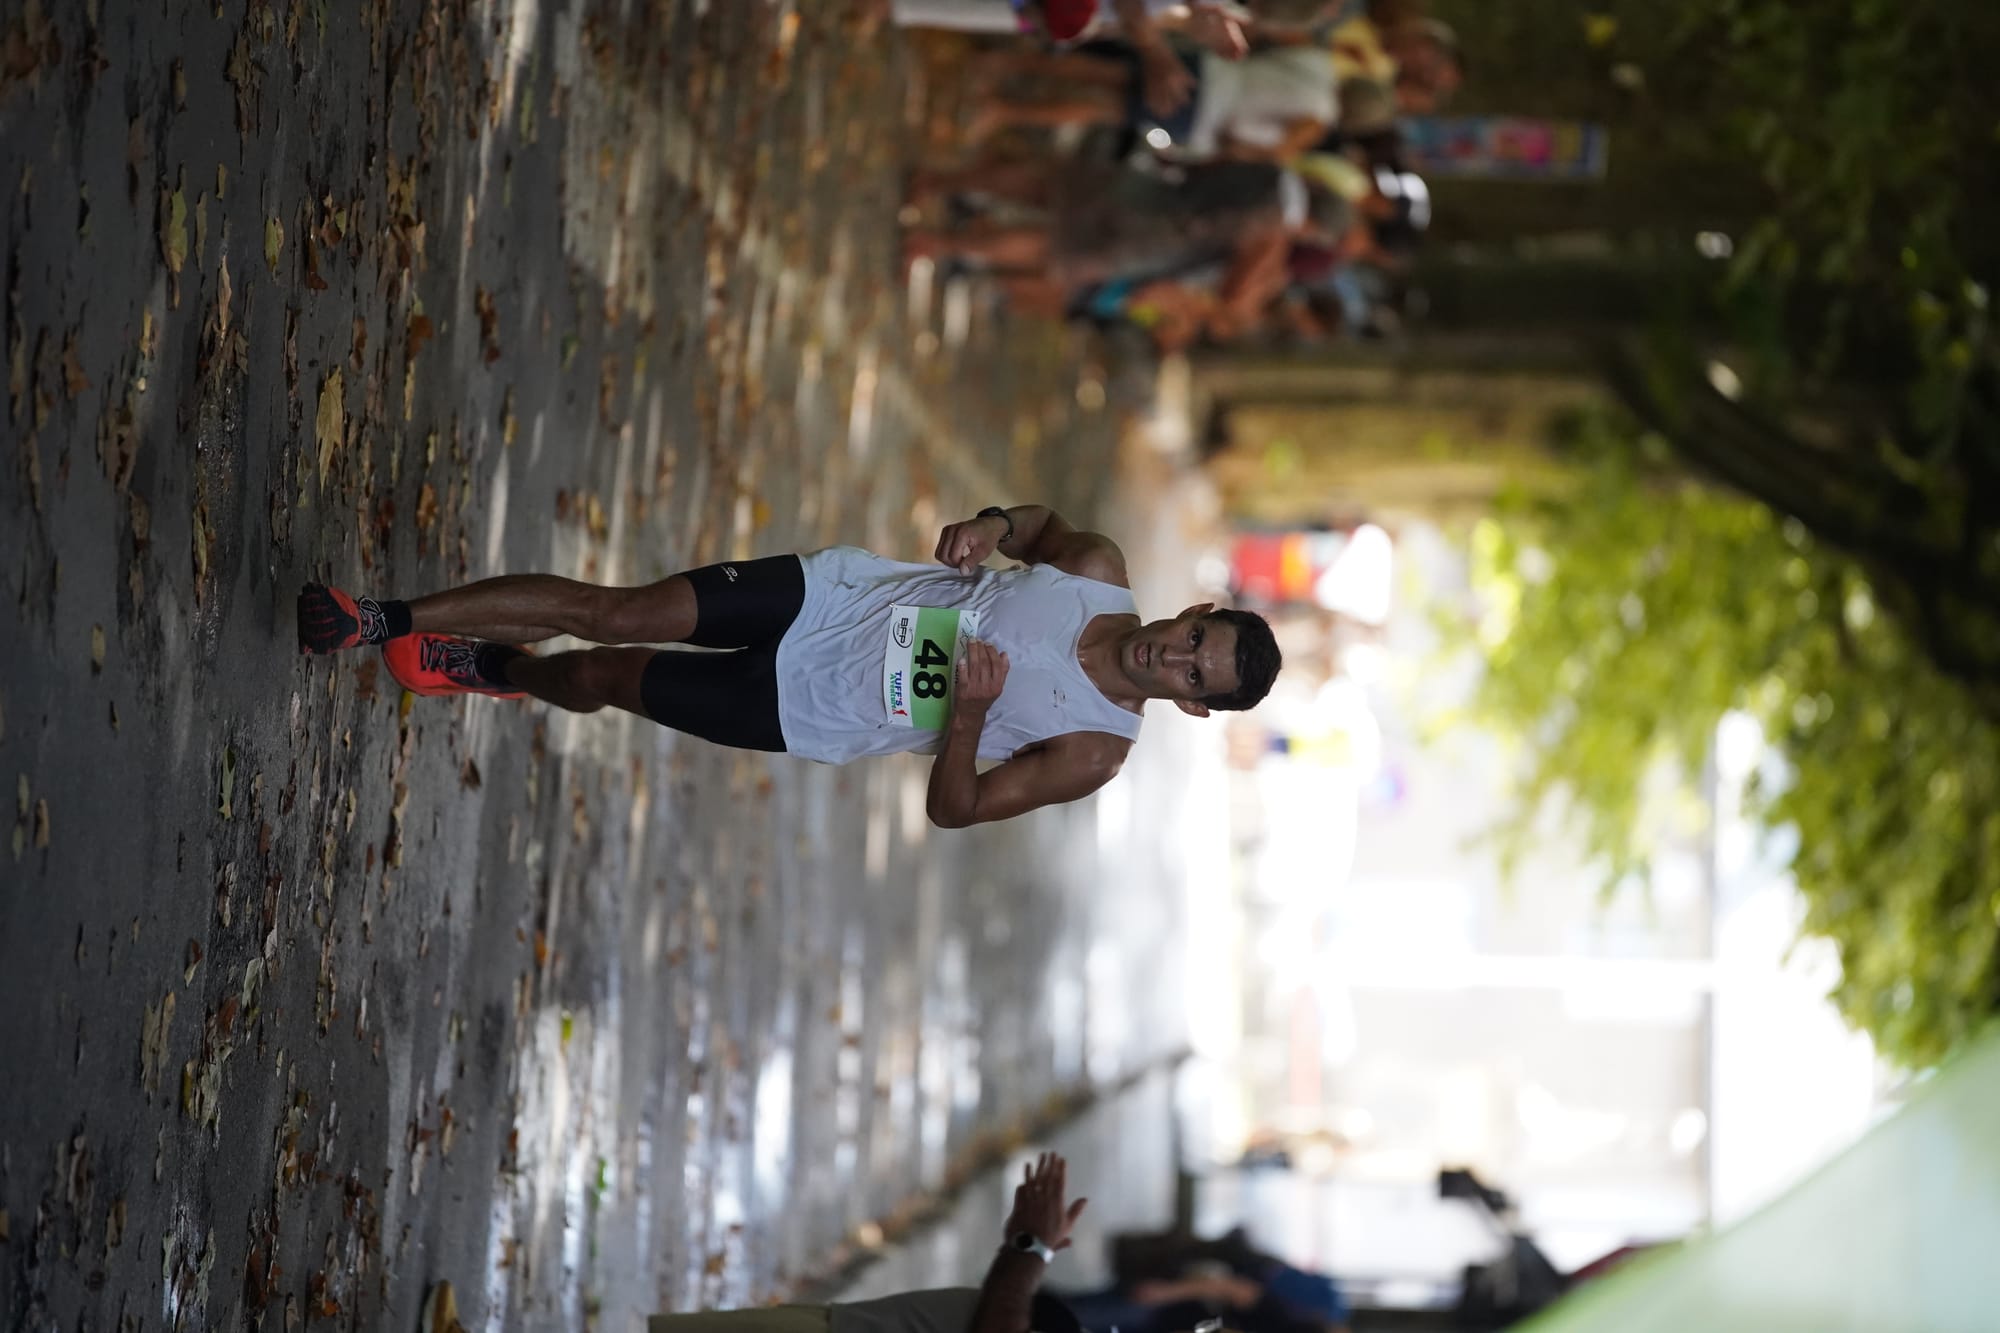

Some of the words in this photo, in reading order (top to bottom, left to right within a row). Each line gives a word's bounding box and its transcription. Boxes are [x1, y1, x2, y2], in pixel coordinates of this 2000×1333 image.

[899, 617, 909, 644] BFP
[912, 639, 949, 699] 48
[895, 670, 903, 706] TUFF'S
